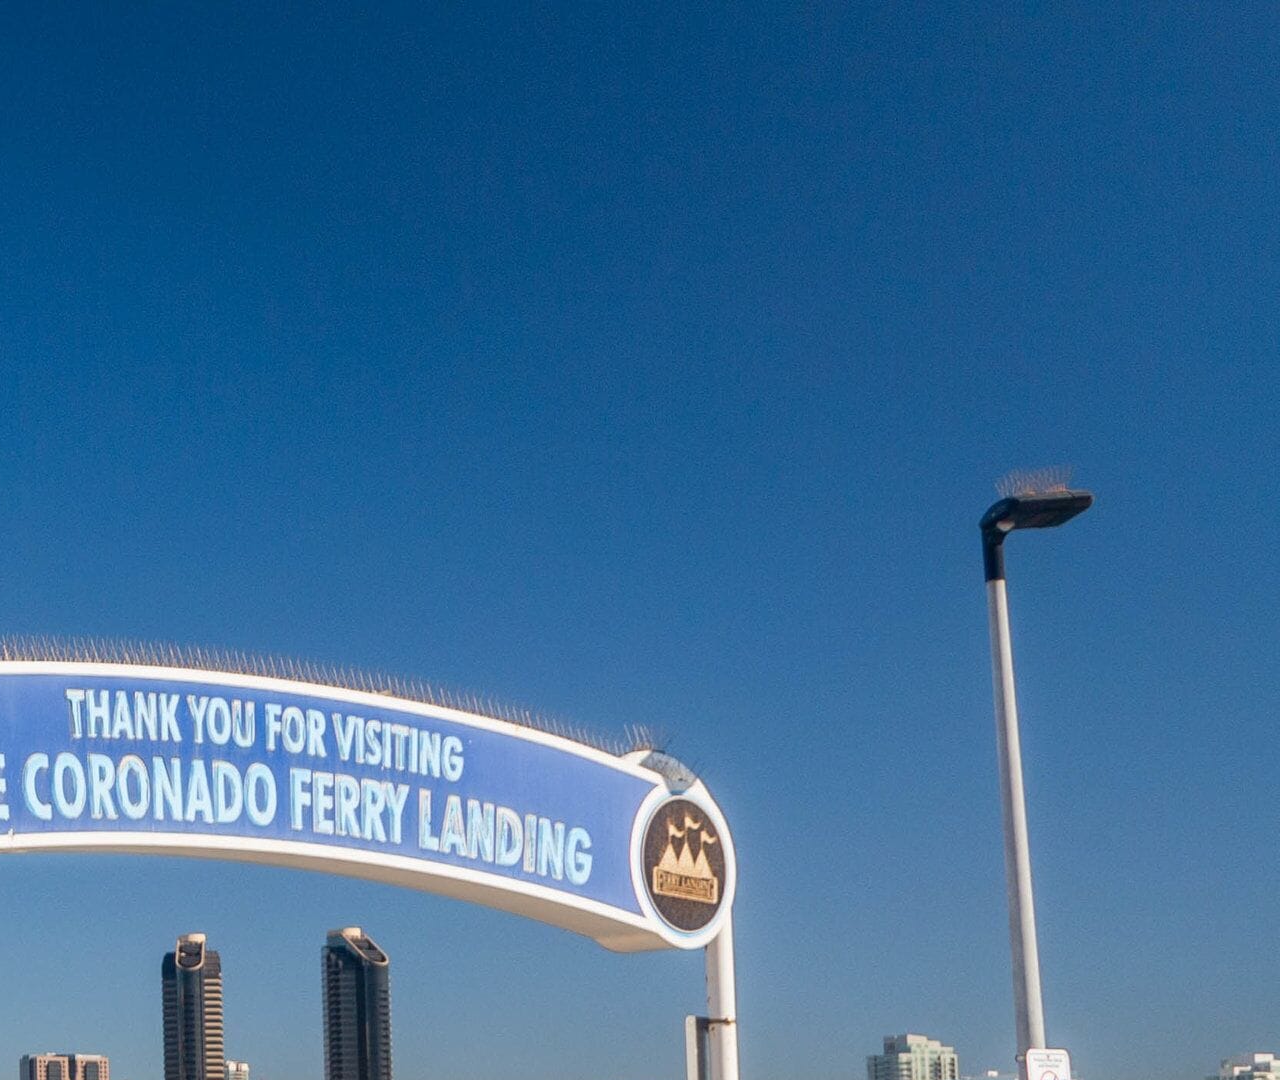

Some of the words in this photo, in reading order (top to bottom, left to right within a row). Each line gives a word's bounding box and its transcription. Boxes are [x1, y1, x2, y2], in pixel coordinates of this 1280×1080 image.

[66, 688, 182, 743] THANK
[186, 695, 256, 748] YOU
[265, 702, 327, 758] FOR
[332, 712, 465, 782] VISITING
[22, 752, 278, 827] CORONADO
[290, 768, 410, 845] FERRY
[418, 788, 593, 886] LANDING
